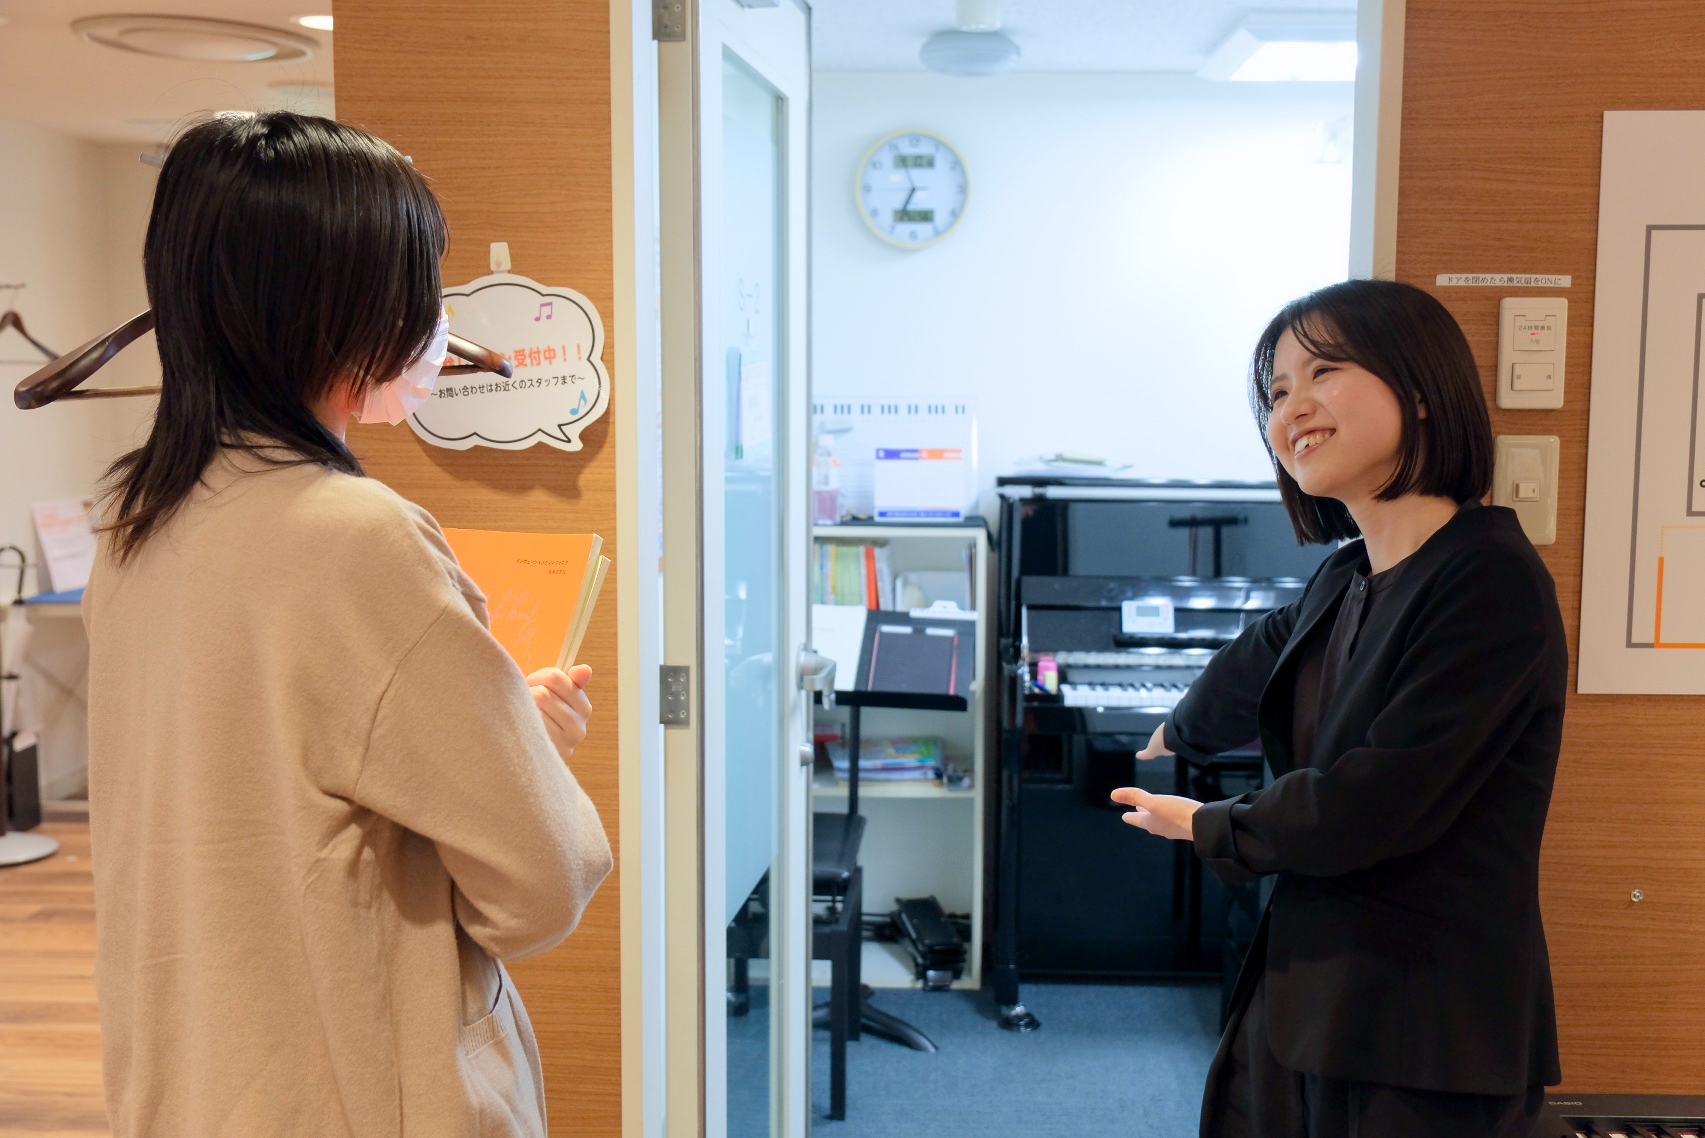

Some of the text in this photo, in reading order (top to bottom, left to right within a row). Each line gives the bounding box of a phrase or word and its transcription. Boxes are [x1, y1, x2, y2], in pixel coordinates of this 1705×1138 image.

[1447, 276, 1561, 286] ドアを閉めたら換気扇をONに
[499, 343, 583, 369] 受付中！！
